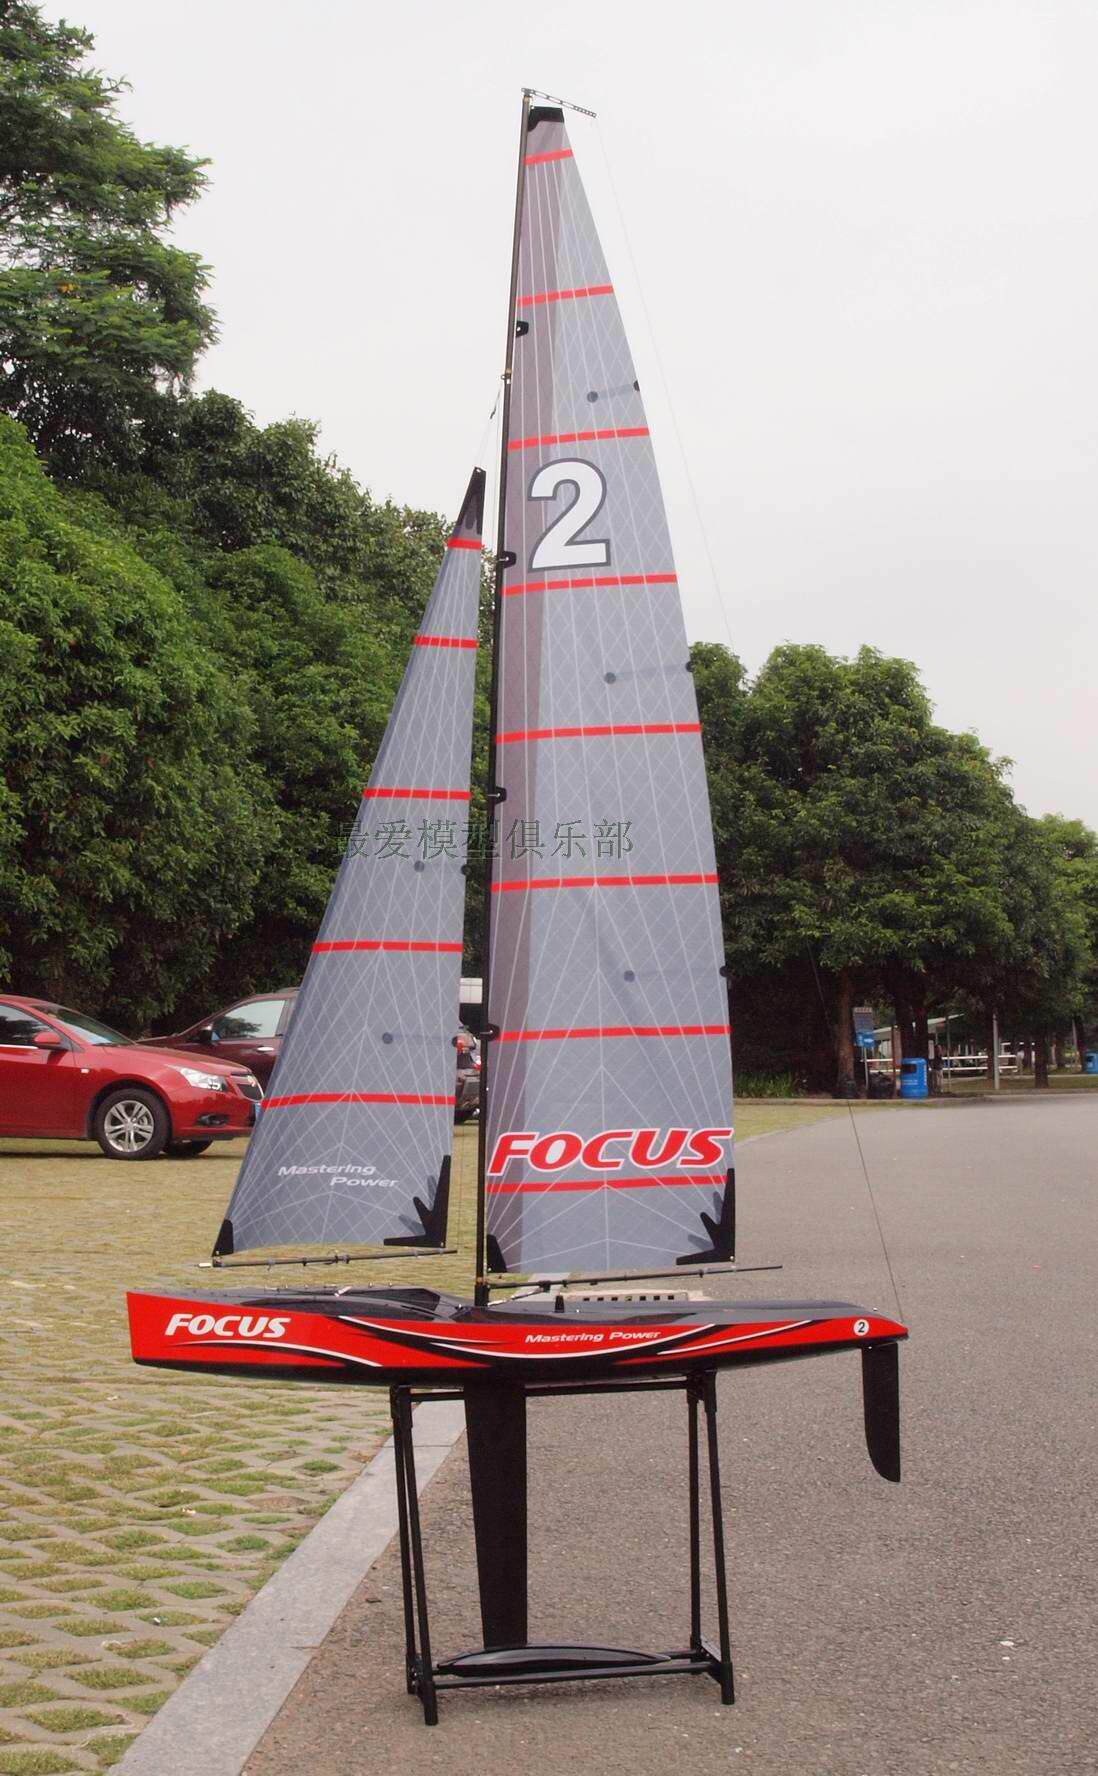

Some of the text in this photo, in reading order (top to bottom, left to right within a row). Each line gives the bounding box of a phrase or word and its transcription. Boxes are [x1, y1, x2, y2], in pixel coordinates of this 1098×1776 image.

[528, 457, 611, 573] 2
[487, 1127, 734, 1176] FOCUS
[278, 1164, 376, 1176] Mastering
[329, 1176, 399, 1187] Power
[164, 1313, 291, 1338] FOCUS
[858, 1321, 865, 1333] 2
[525, 1331, 661, 1343] Mastering Power
